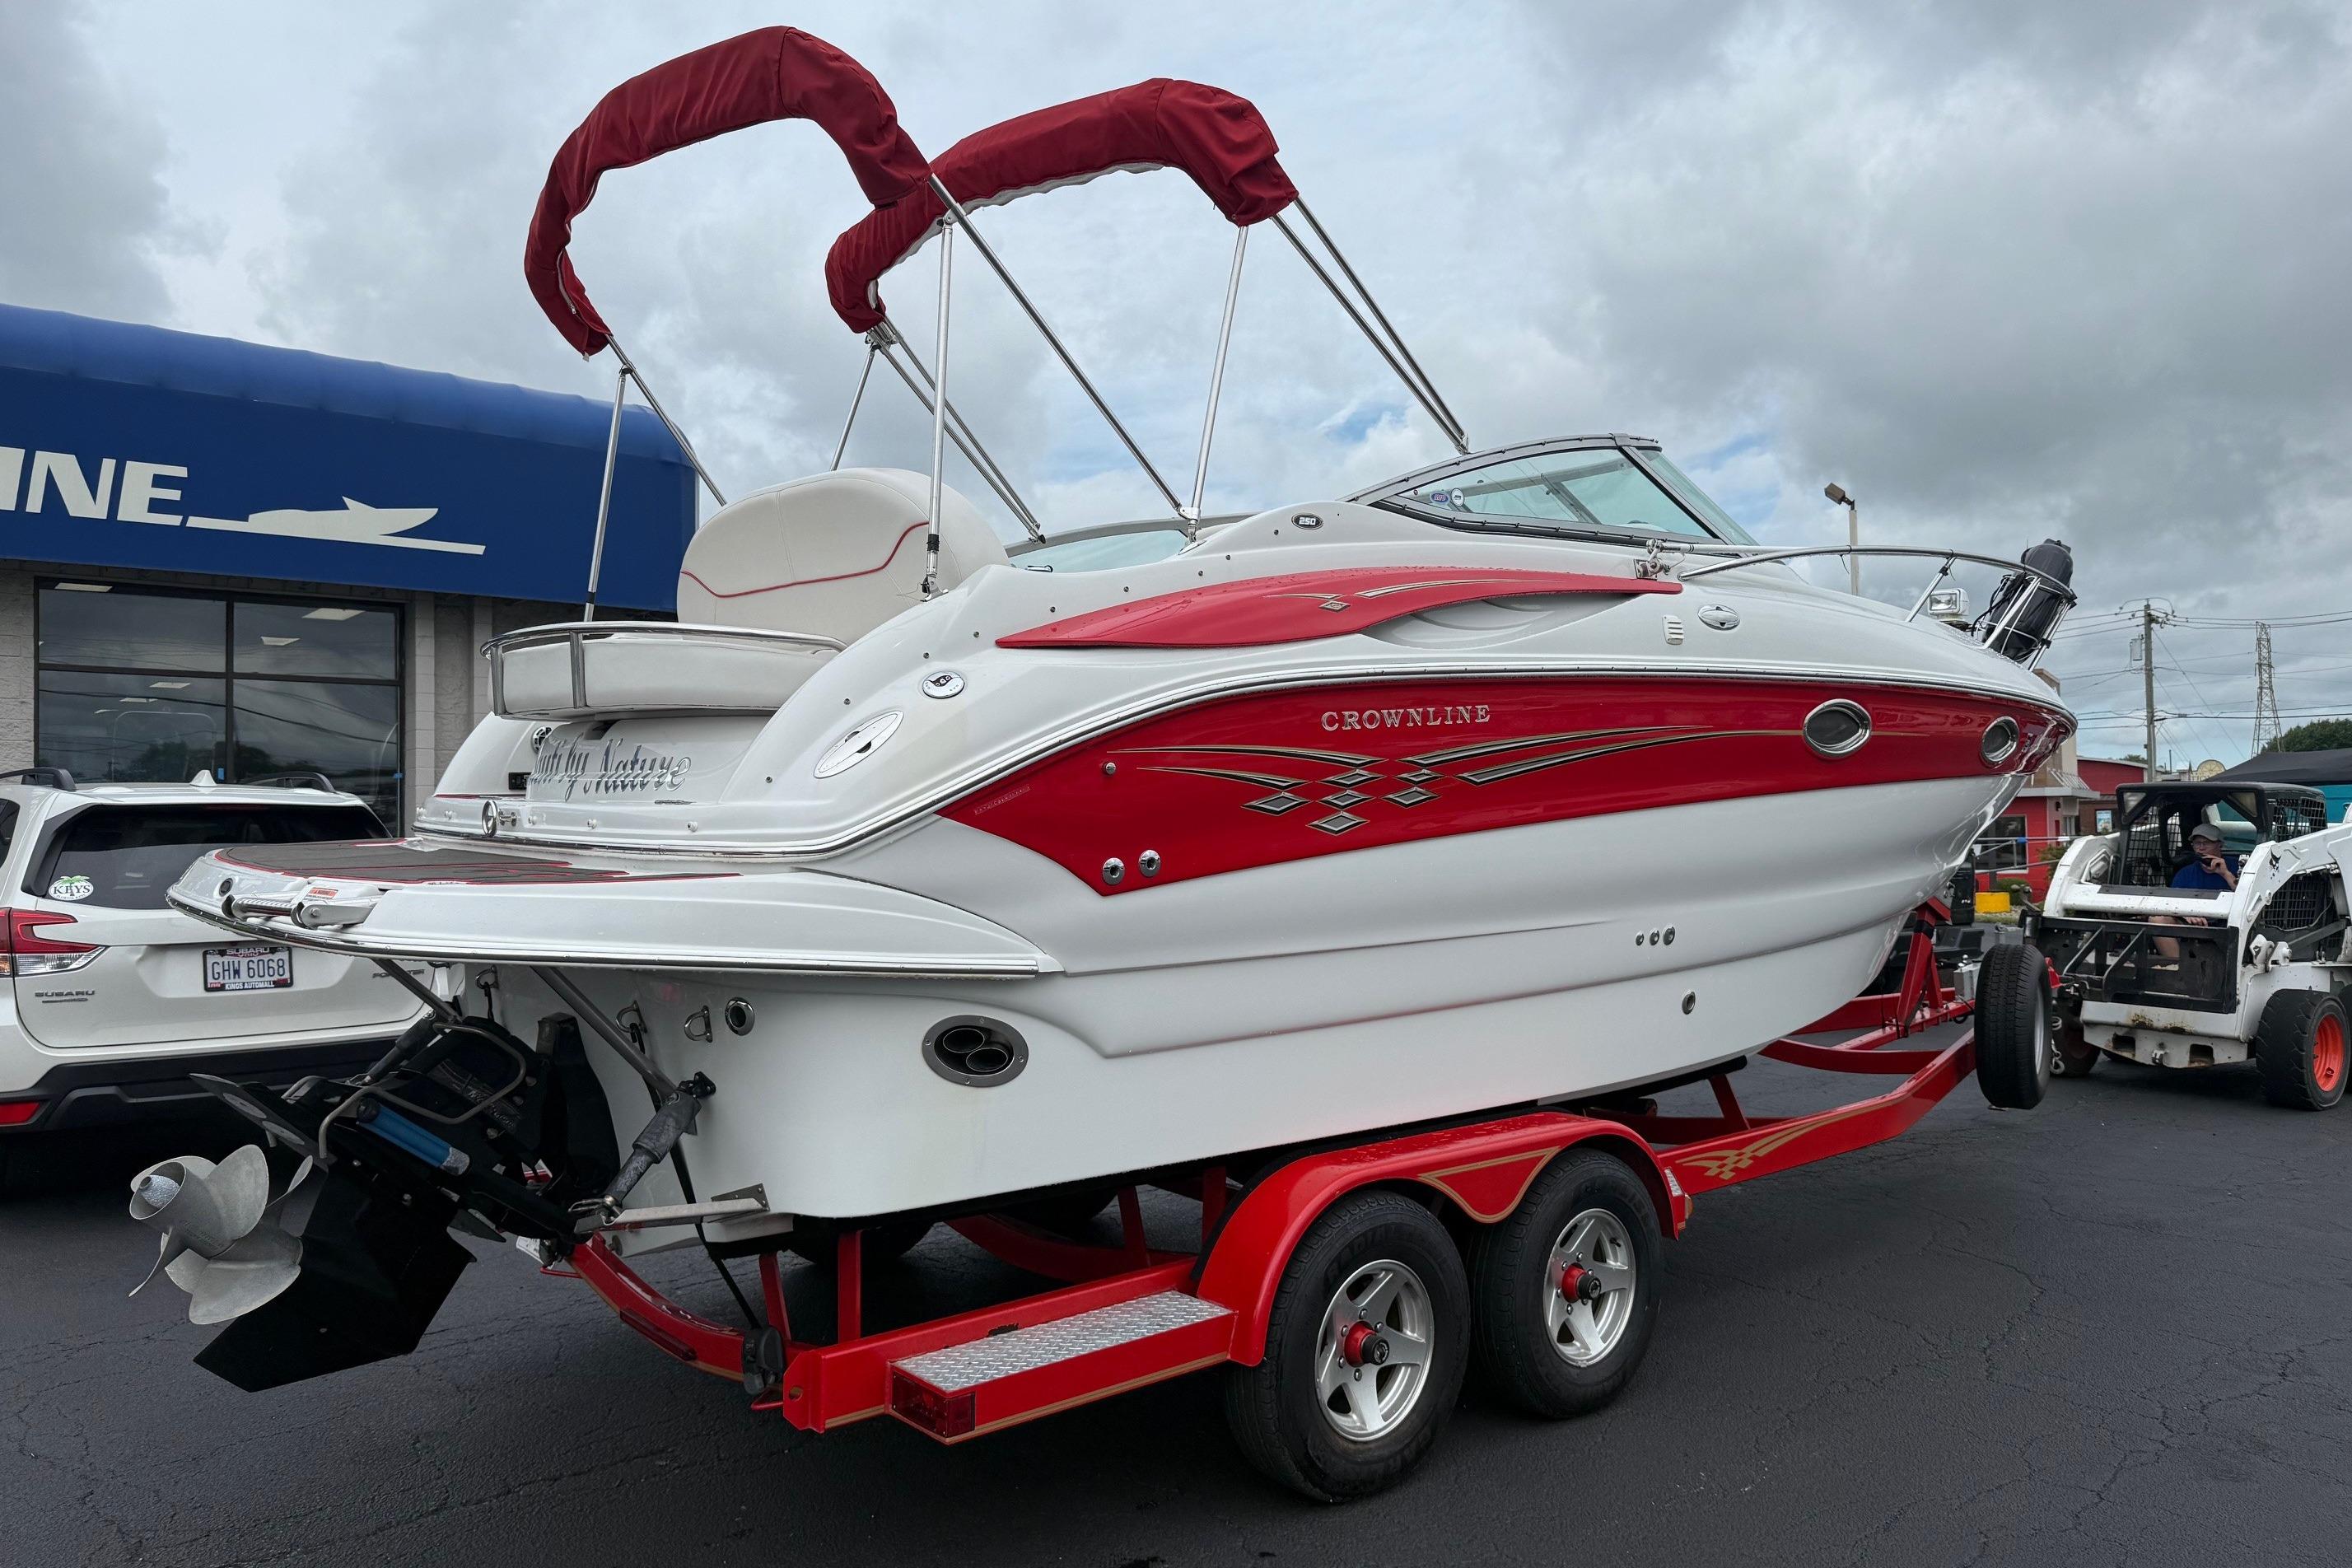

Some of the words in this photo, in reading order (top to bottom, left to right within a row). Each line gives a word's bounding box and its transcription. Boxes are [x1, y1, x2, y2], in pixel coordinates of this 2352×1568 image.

[1299, 517, 1316, 525] 250
[1321, 704, 1490, 730] CROWNLINE
[583, 738, 692, 795] Nature
[54, 885, 91, 894] KEYS
[212, 960, 240, 980] GHW
[247, 958, 286, 978] 6068
[244, 981, 275, 989] AUTOMALL
